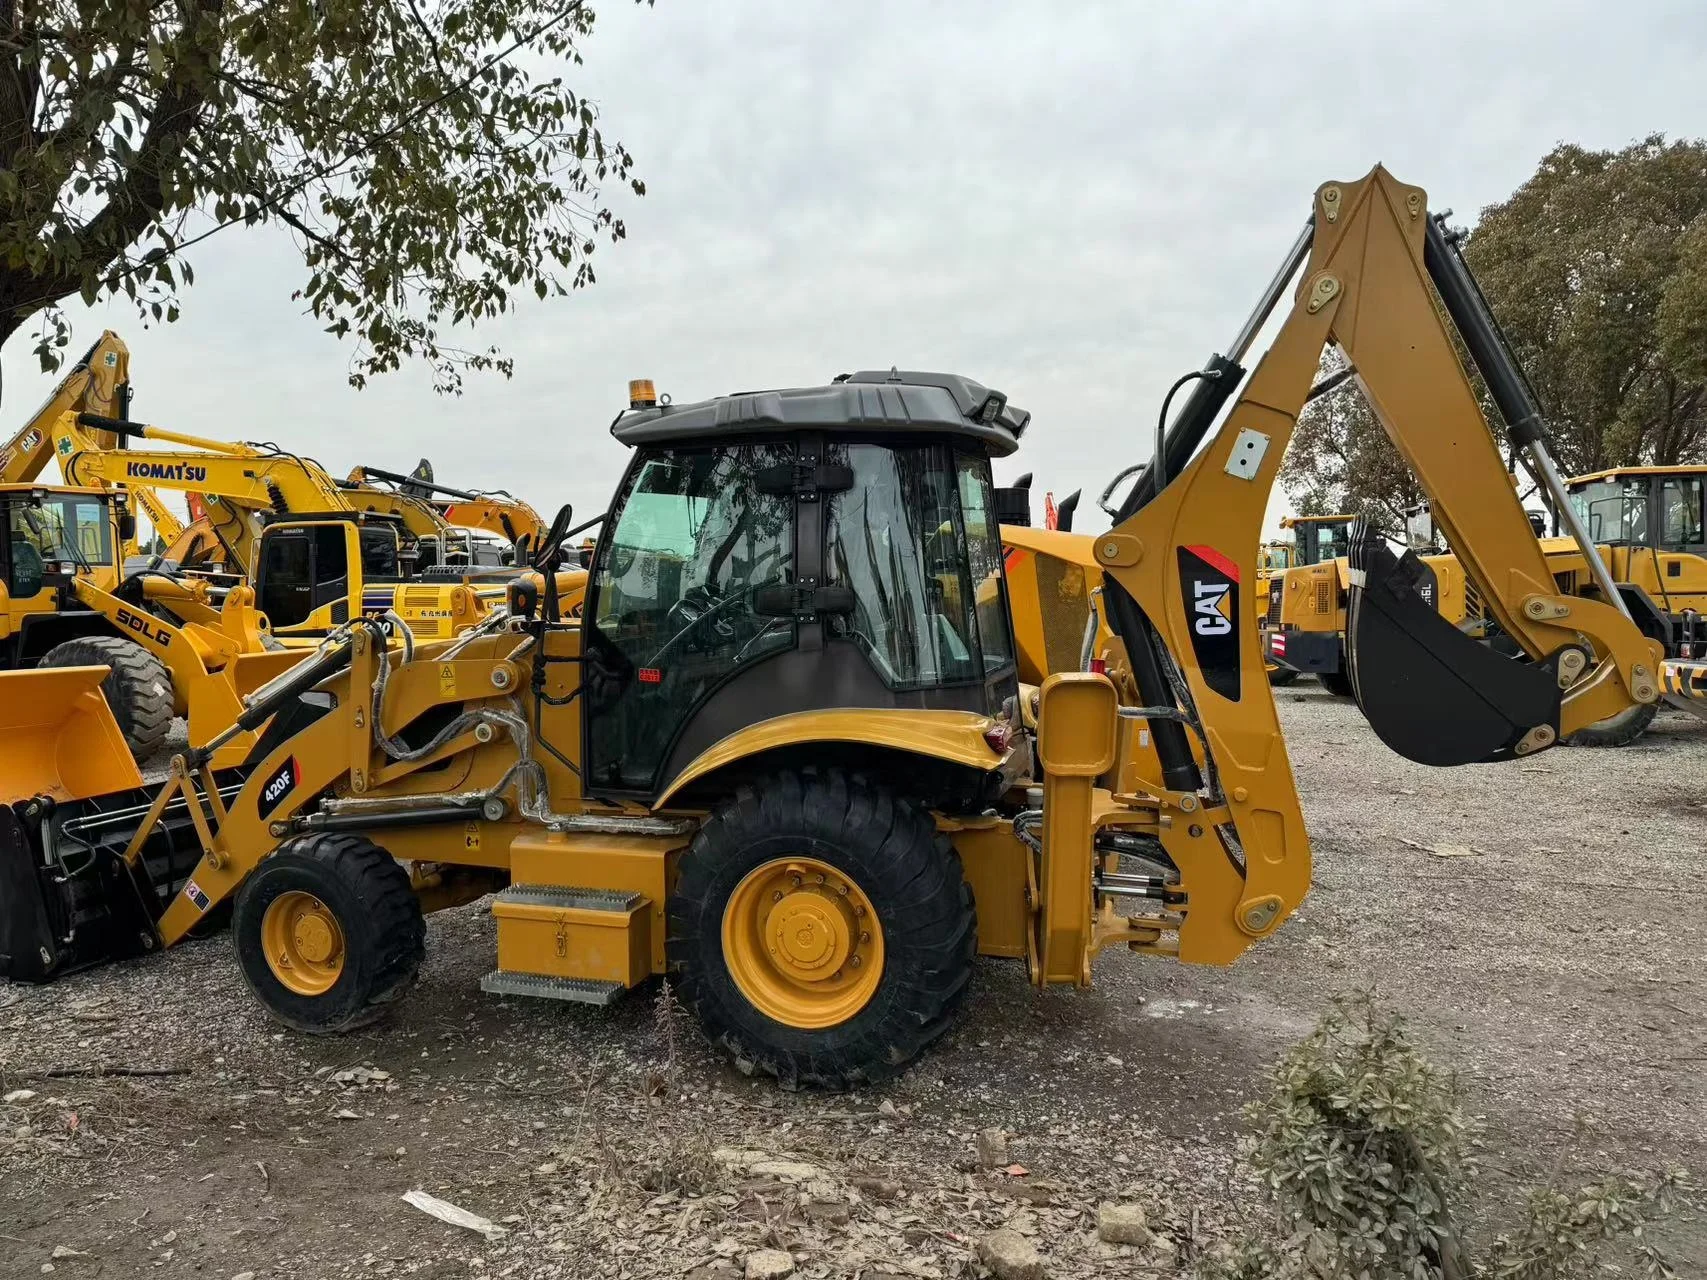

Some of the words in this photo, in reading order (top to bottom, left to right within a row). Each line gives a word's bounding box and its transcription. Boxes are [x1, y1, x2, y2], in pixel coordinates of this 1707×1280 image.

[127, 461, 206, 481] KOMATSU
[135, 490, 160, 522] KOMATSU
[1194, 580, 1232, 636] CAT
[115, 607, 172, 647] SDLG
[265, 770, 290, 802] 420F
